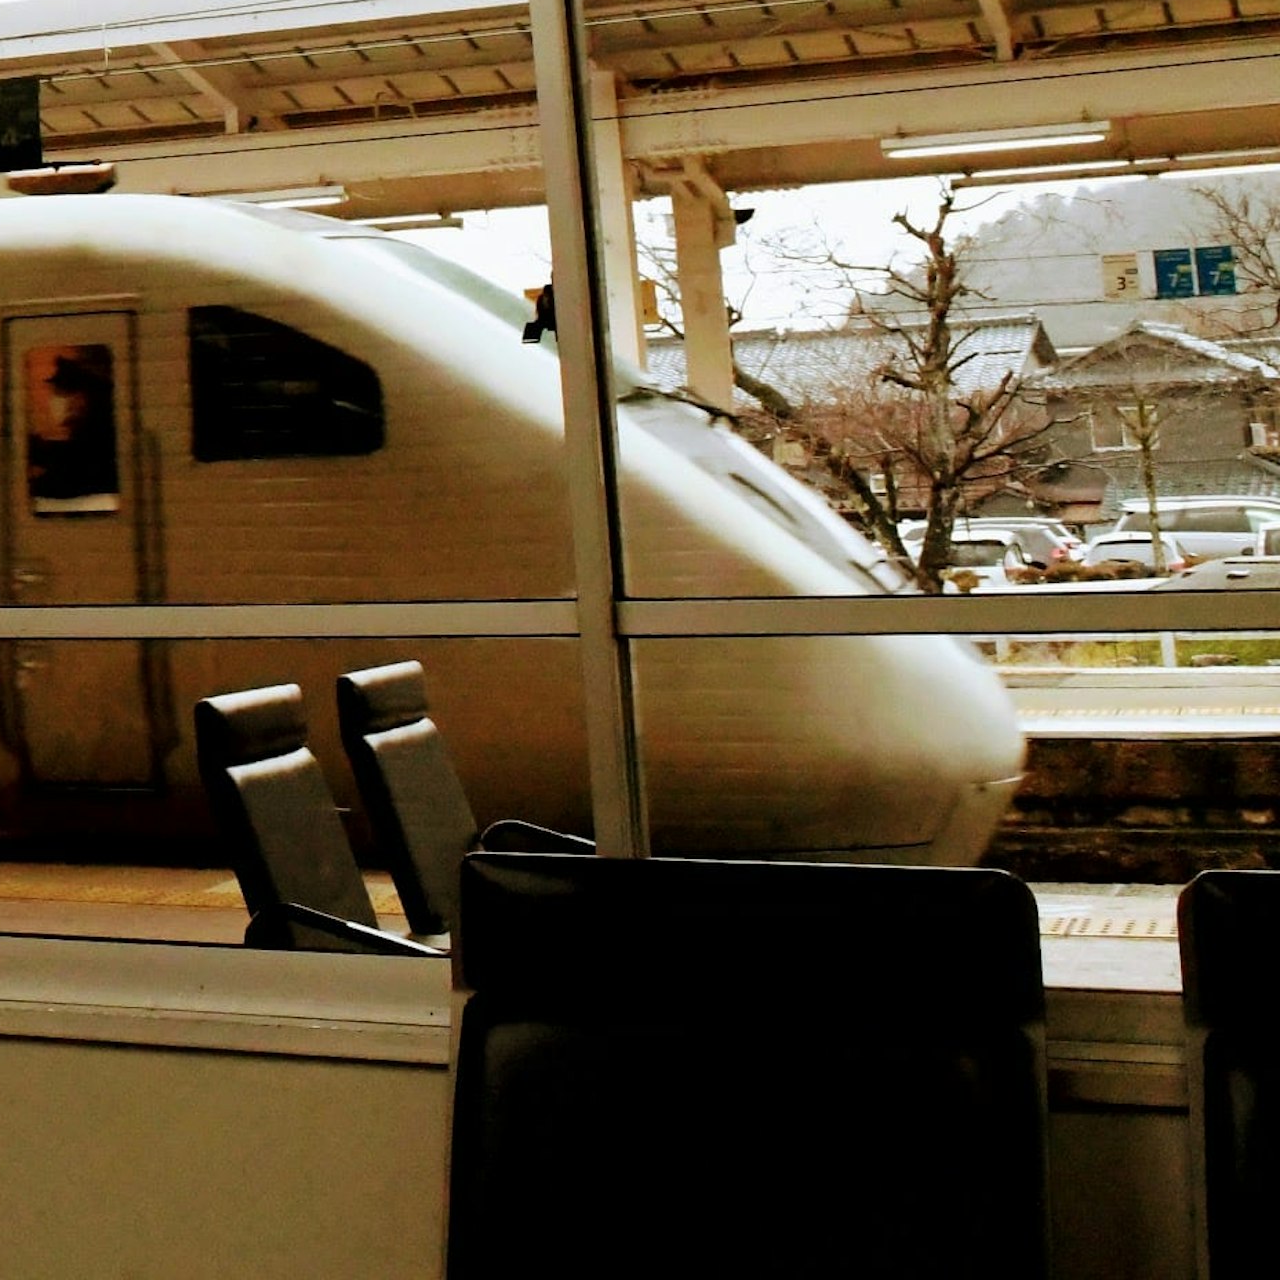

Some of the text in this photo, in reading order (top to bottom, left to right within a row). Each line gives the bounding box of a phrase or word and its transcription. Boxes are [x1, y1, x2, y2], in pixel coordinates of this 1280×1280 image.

[1117, 276, 1126, 291] 3
[1167, 272, 1179, 288] 7
[1209, 270, 1220, 286] 7
